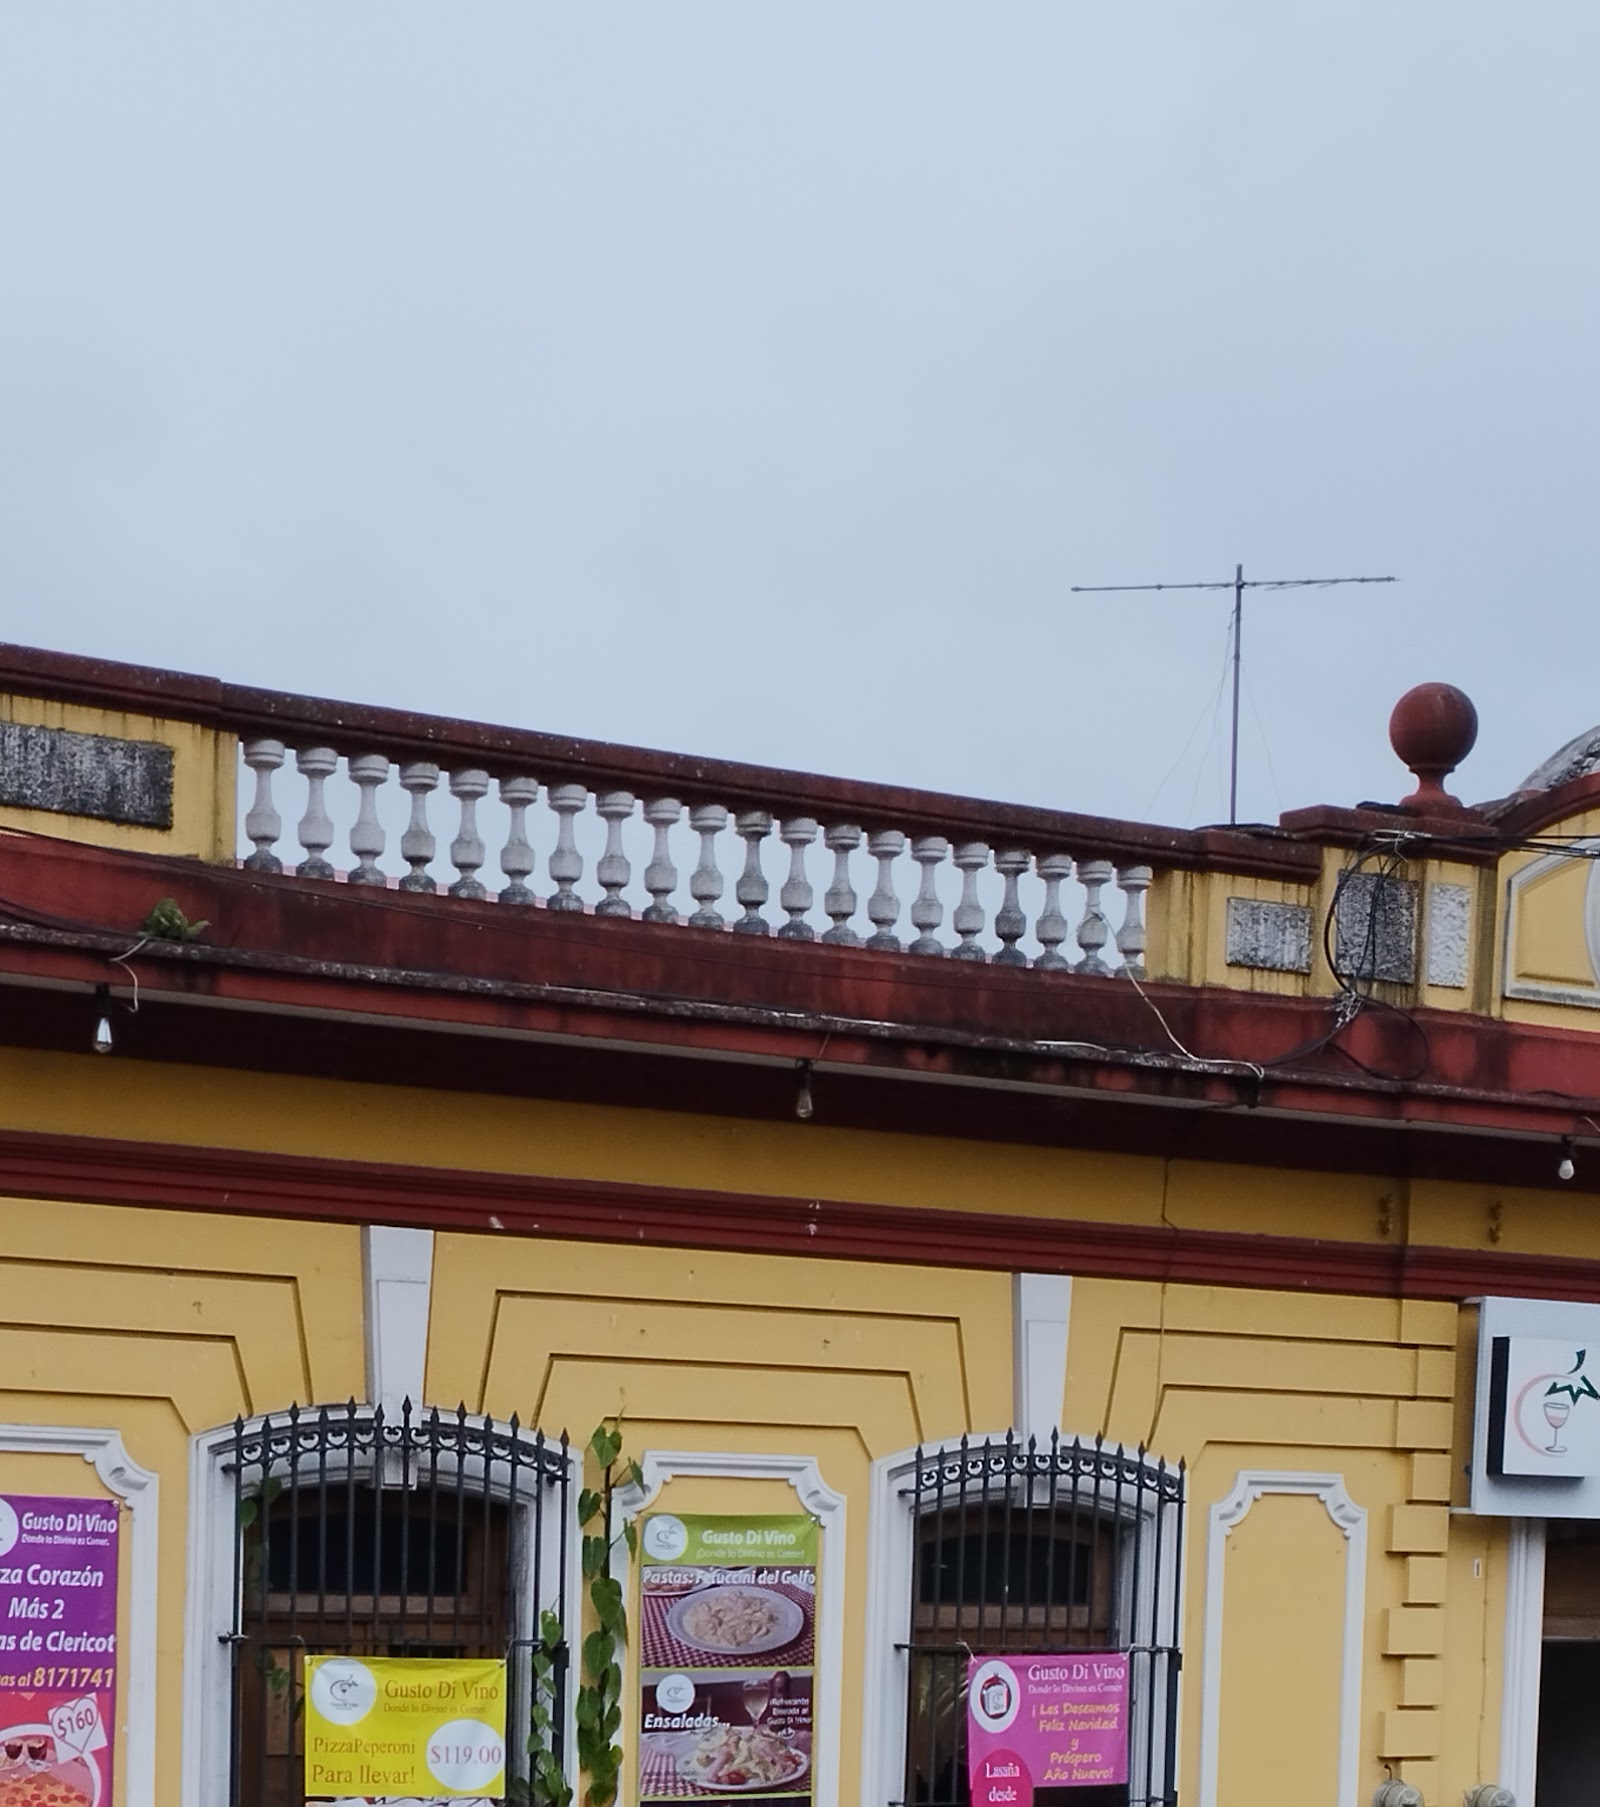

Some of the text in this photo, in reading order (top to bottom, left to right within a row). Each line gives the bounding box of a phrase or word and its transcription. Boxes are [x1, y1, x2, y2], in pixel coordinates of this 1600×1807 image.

[21, 1512, 117, 1533] Gusto Di Vino
[701, 1529, 797, 1546] Gusto Di Vino
[27, 1564, 103, 1587] Corazón
[642, 1570, 694, 1585] Pastas:
[758, 1569, 779, 1585] del
[781, 1570, 816, 1585] Golfo
[8, 1597, 64, 1619] Más 2
[20, 1630, 42, 1651] de
[46, 1631, 115, 1653] Clericot
[18, 1672, 31, 1687] al
[33, 1667, 113, 1688] 8171741
[1028, 1663, 1125, 1681] Gusto Di Vino
[385, 1679, 498, 1700] Gusto Di Vino
[1028, 1684, 1053, 1694] Donde
[384, 1703, 410, 1713] Donde
[1063, 1702, 1120, 1715] Deseamos
[58, 1708, 94, 1740] $160
[1039, 1716, 1119, 1732] Feliz Navidad
[1070, 1738, 1079, 1751] y
[430, 1745, 501, 1764] $119.00
[1050, 1751, 1102, 1767] Próspero
[312, 1764, 415, 1784] Para llevar!
[1043, 1767, 1114, 1781] Año Nuevo!
[988, 1786, 1017, 1802] desde
